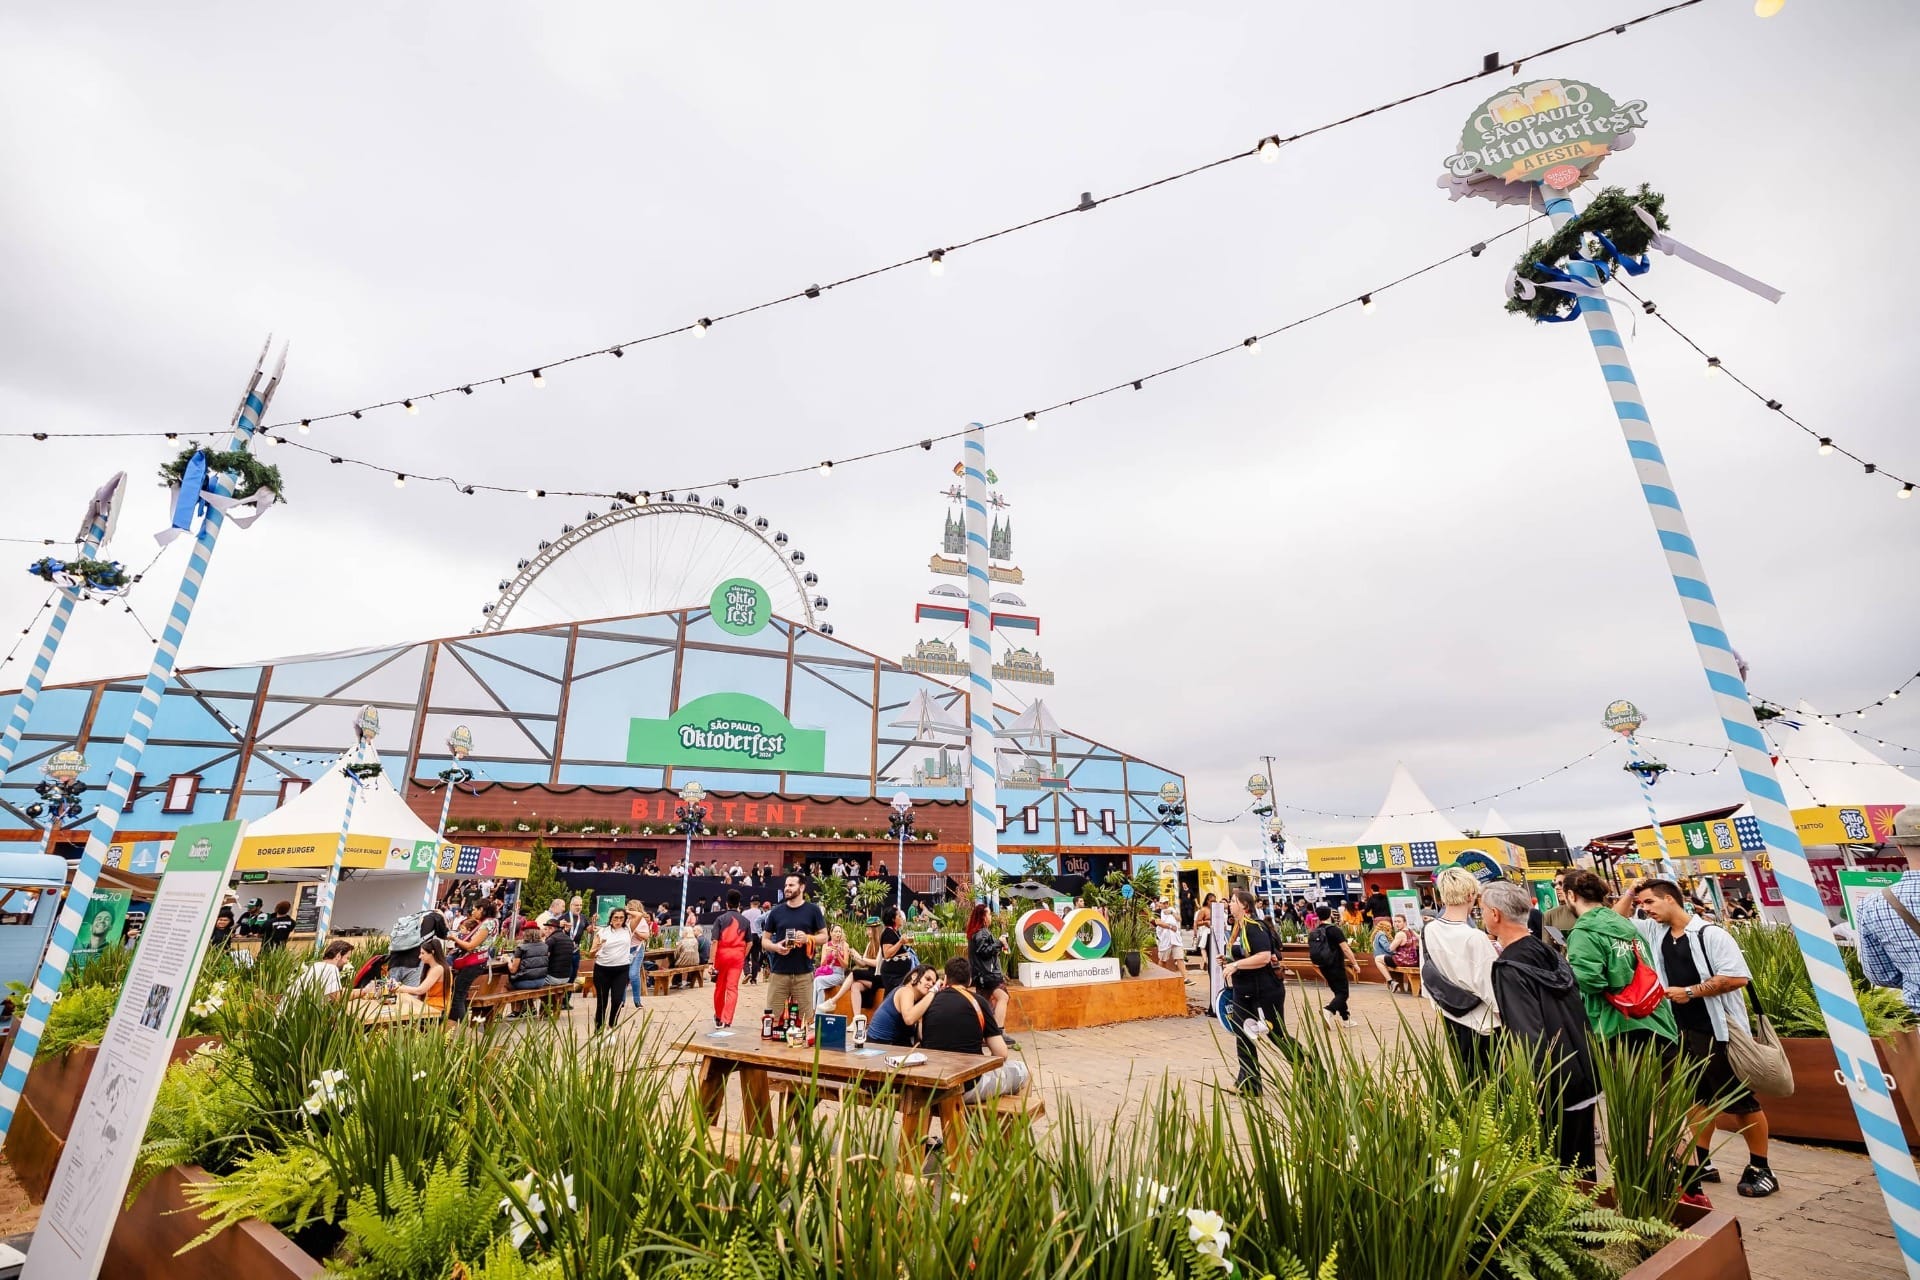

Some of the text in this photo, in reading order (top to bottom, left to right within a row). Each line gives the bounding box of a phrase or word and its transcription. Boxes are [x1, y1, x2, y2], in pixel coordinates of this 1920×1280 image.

[1481, 102, 1595, 145] SÃO PAULO
[1443, 100, 1648, 178] Oktoberfest
[1523, 144, 1585, 171] A FESTA
[726, 607, 755, 625] fest
[710, 719, 760, 734] SÃO PAULO
[679, 724, 784, 756] Oktoberfest
[631, 798, 807, 824] BIERTENT
[1799, 822, 1824, 830] TATTOO
[257, 846, 316, 856] BORGER BURGER
[363, 848, 382, 856] BURGER
[1043, 966, 1114, 979] AlemanhanoBrasil
